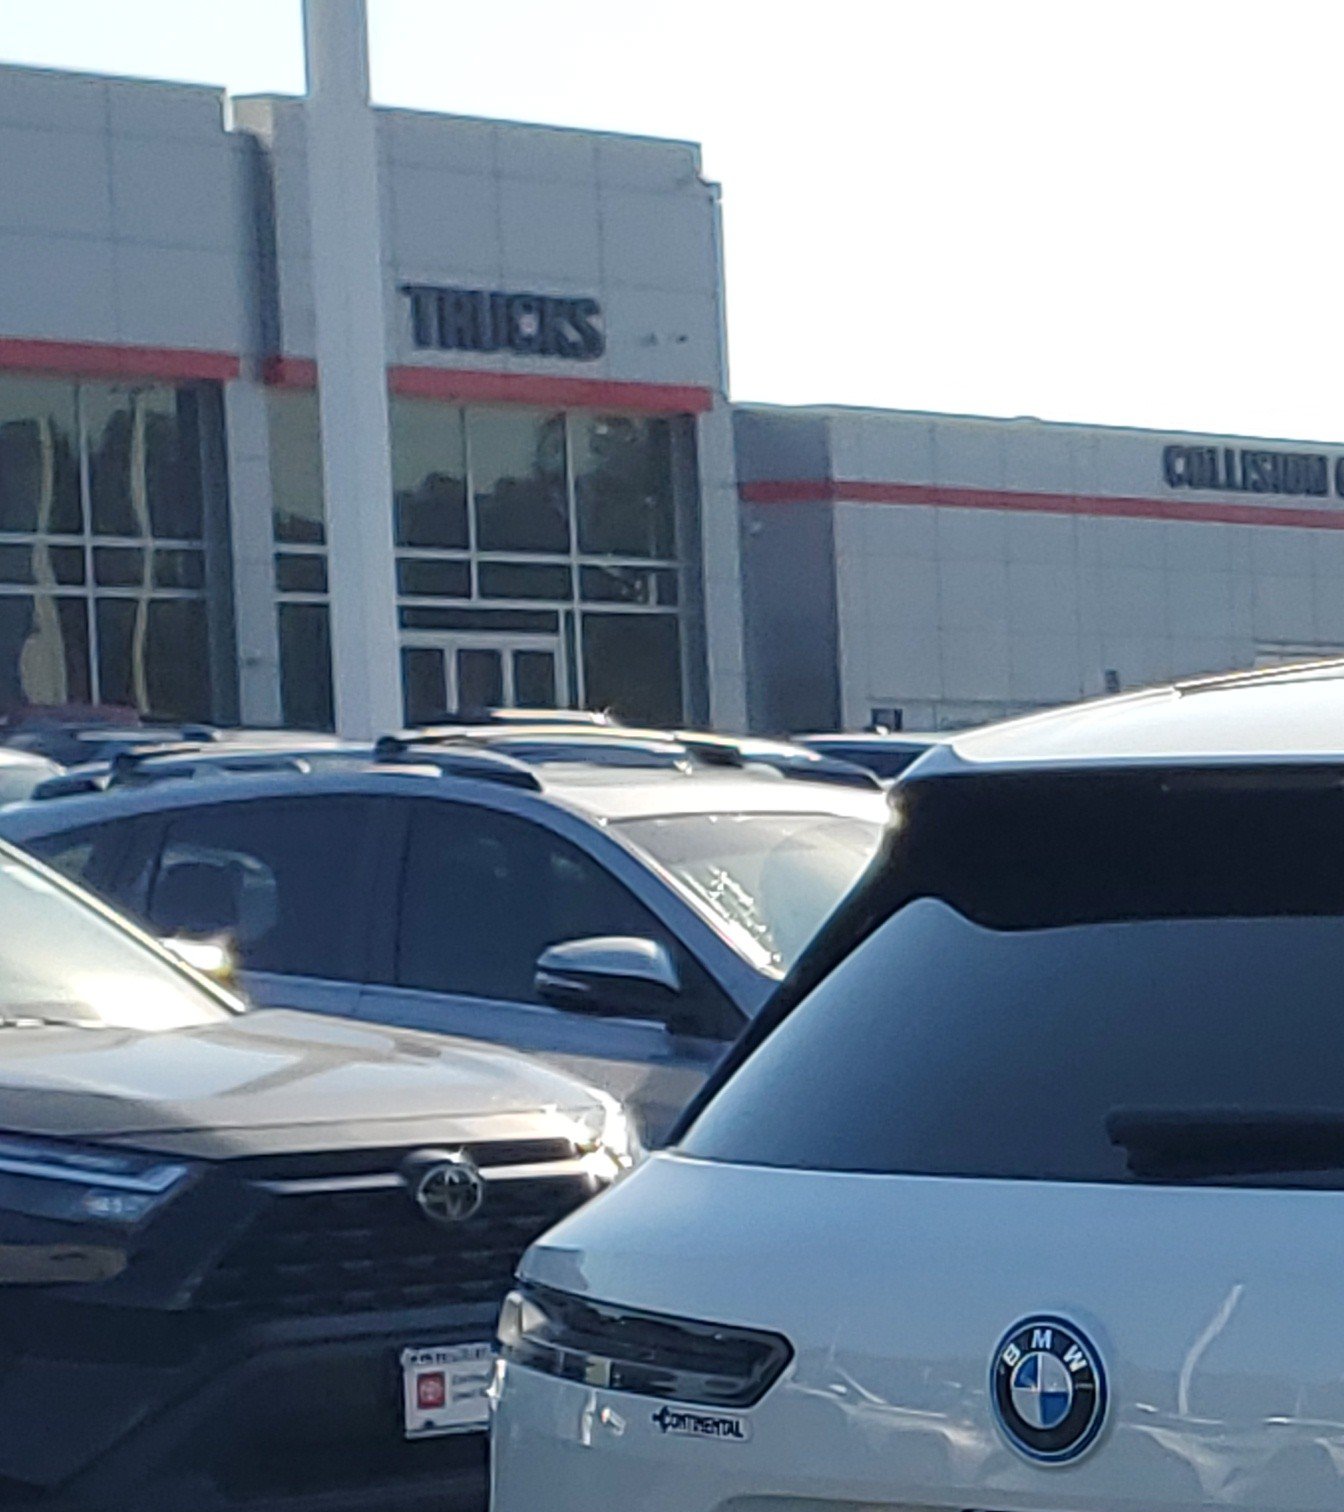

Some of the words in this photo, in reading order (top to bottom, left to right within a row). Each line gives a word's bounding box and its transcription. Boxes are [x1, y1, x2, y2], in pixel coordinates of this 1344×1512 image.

[396, 285, 606, 362] TRUCKS
[1162, 445, 1329, 496] COLLISION
[1002, 1328, 1088, 1373] BMW
